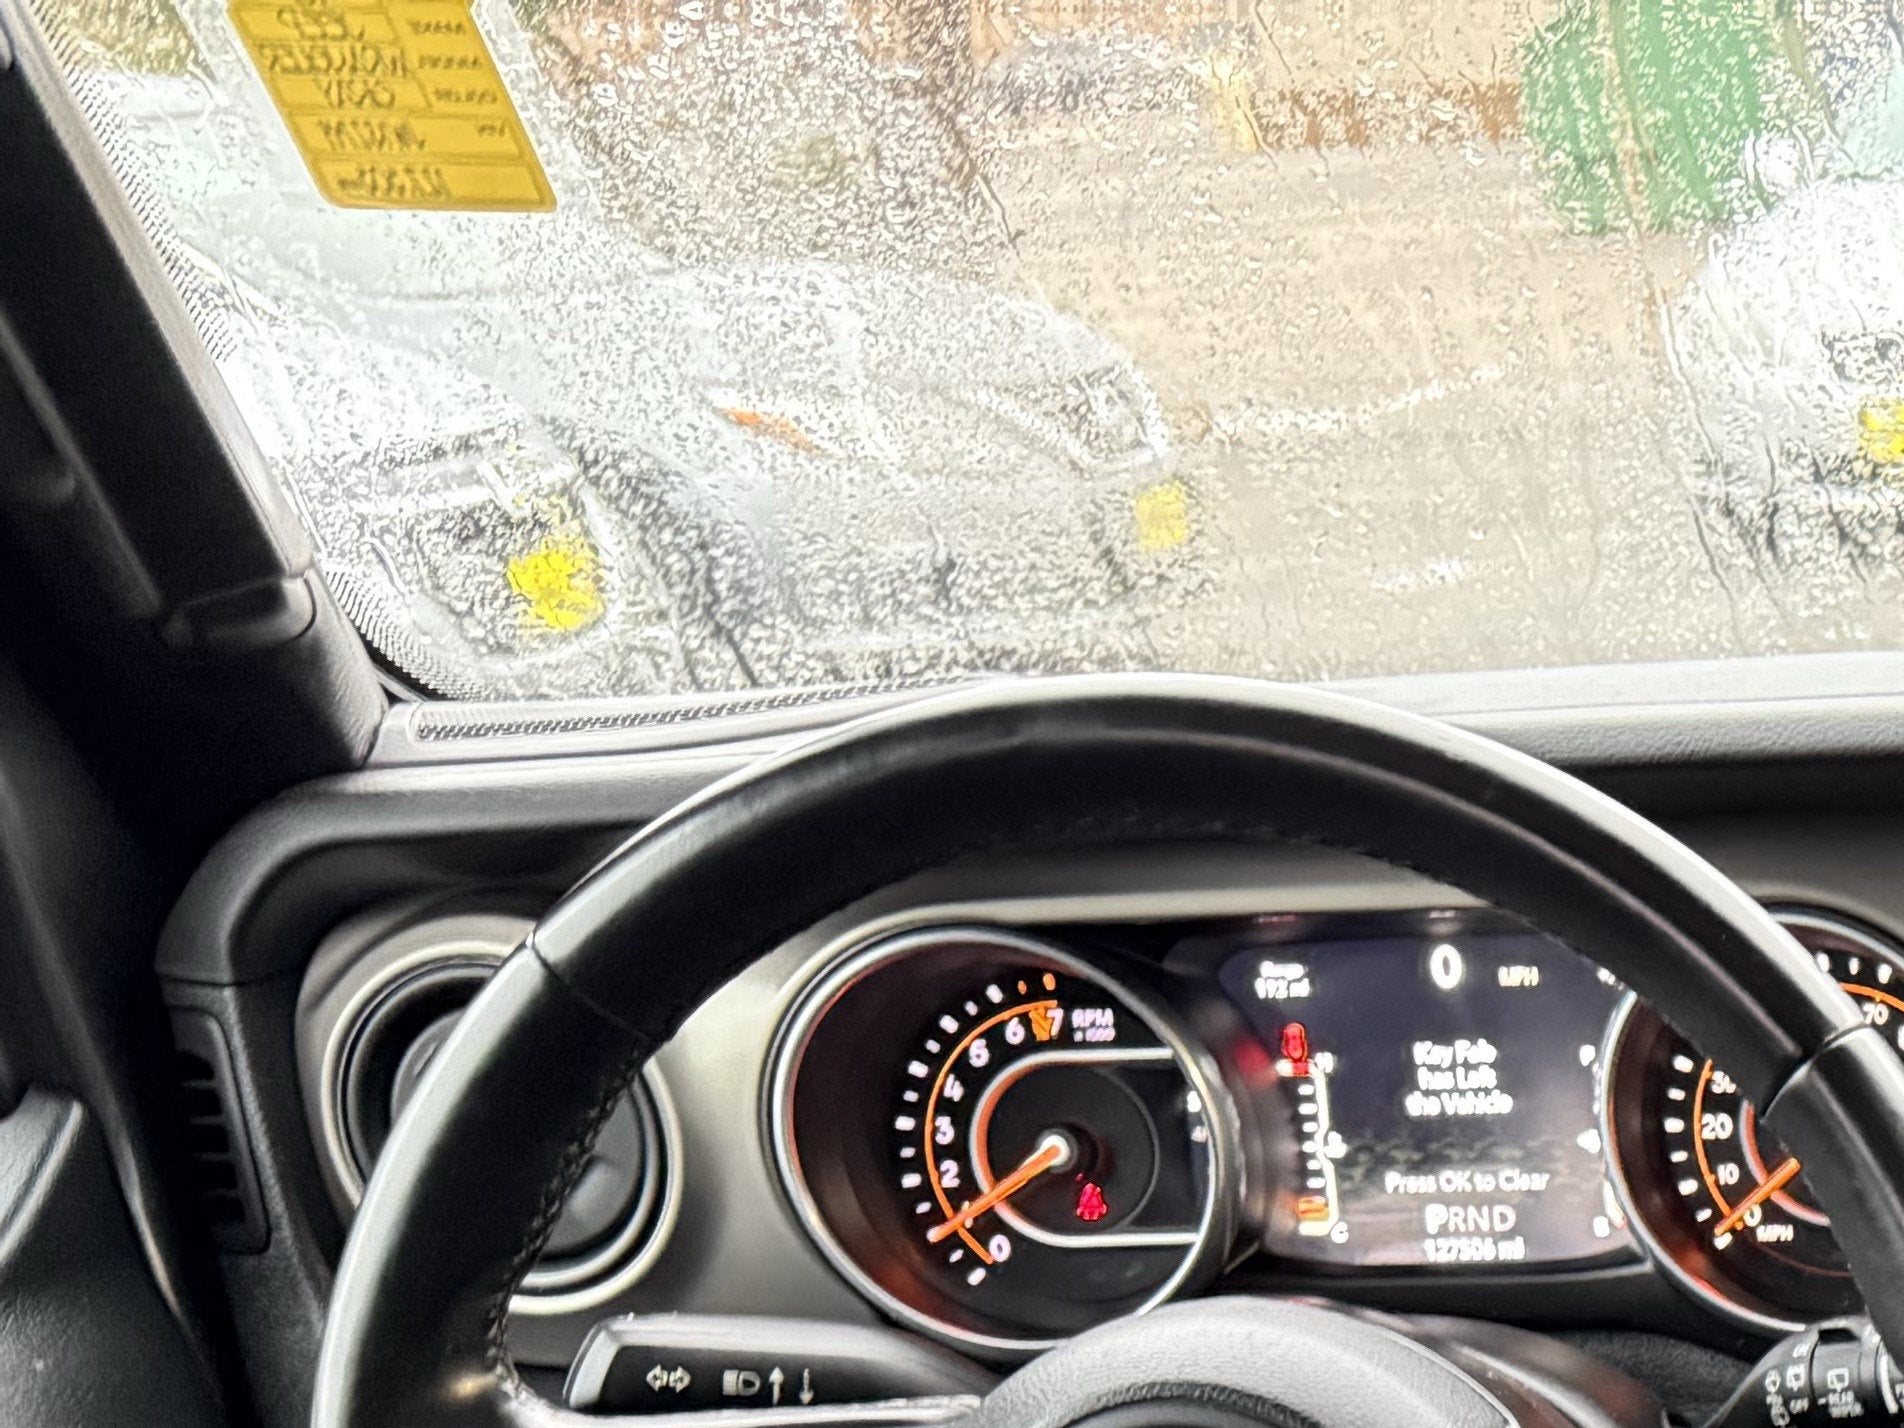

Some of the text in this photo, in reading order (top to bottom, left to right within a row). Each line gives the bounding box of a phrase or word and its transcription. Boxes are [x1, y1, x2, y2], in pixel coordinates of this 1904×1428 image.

[1430, 943, 1462, 990] 0
[1005, 1017, 1025, 1045] 6
[969, 1040, 990, 1067] 5
[943, 1074, 964, 1102] 4
[935, 1116, 954, 1144] 3
[1701, 1113, 1734, 1140] 20
[940, 1160, 960, 1188] 2
[1385, 1169, 1550, 1193] Press OK to Clear
[1718, 1164, 1740, 1185] 10
[989, 1233, 1011, 1263] 0
